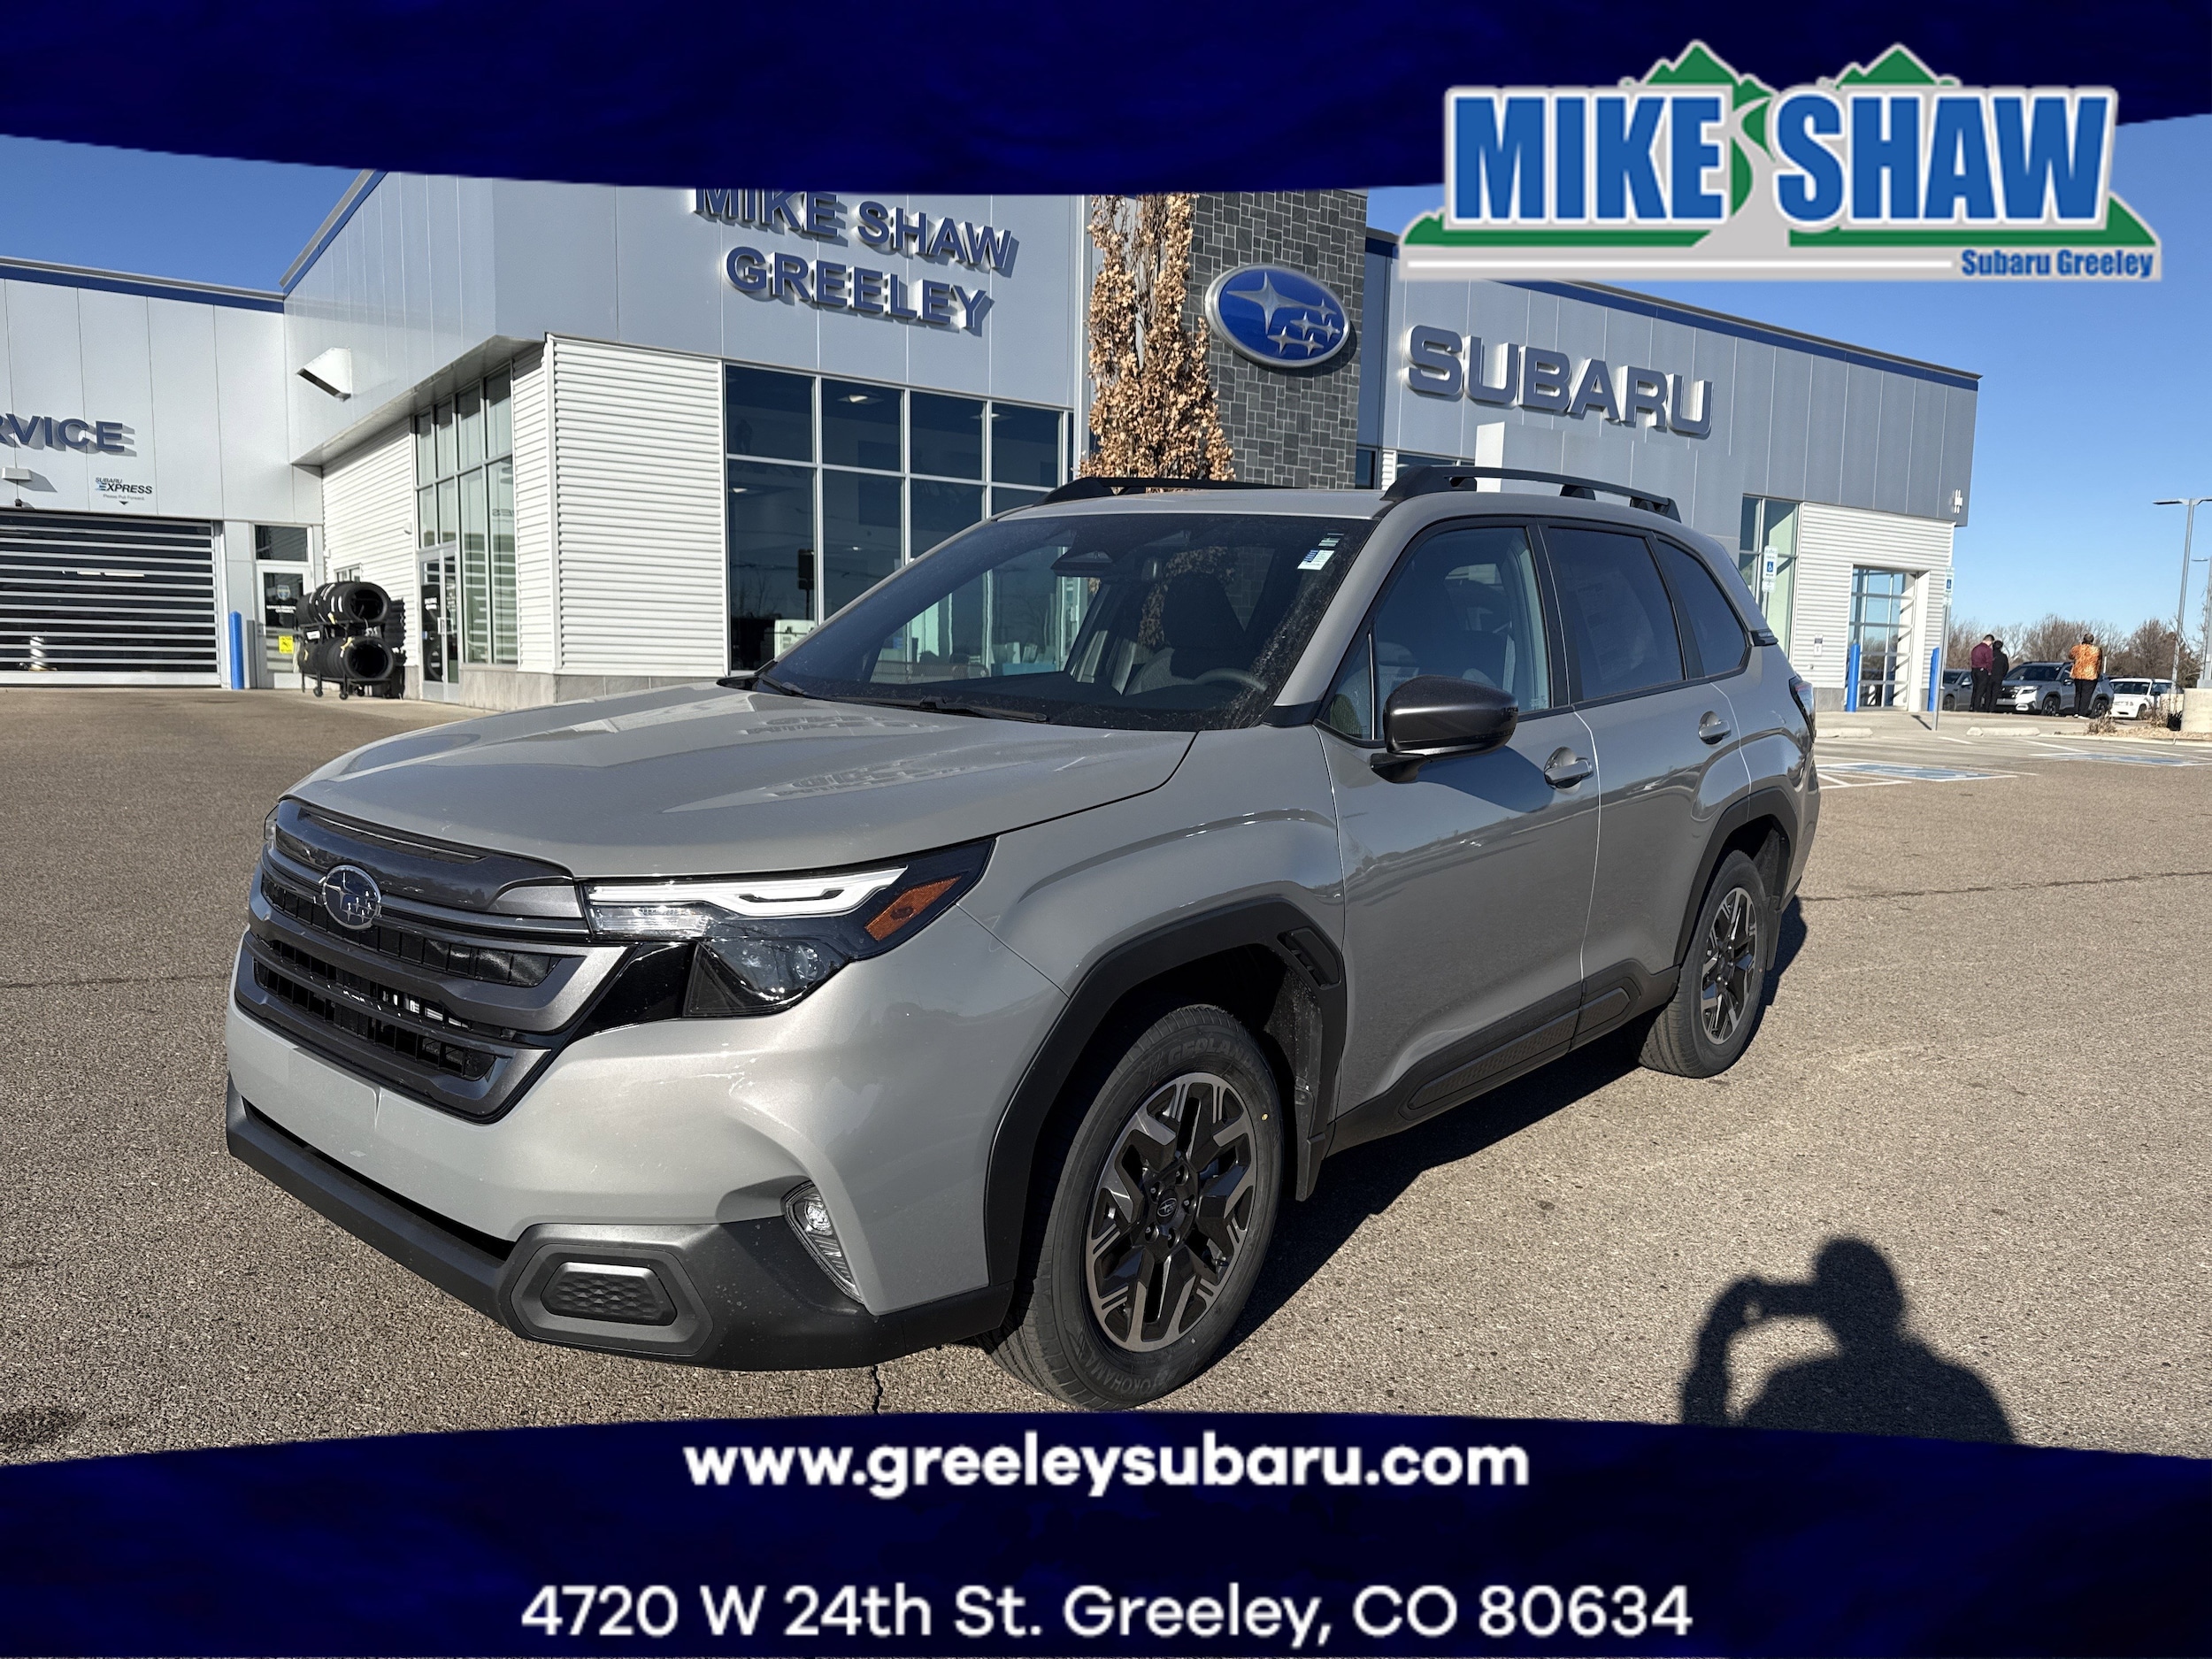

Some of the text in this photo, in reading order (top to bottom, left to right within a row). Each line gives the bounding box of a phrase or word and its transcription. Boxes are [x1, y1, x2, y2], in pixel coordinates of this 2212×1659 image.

[695, 188, 1011, 269] MIKE SHAW
[725, 246, 987, 328] GREELEY
[1404, 325, 1715, 436] SUBARU
[96, 482, 153, 495] EXPRESS
